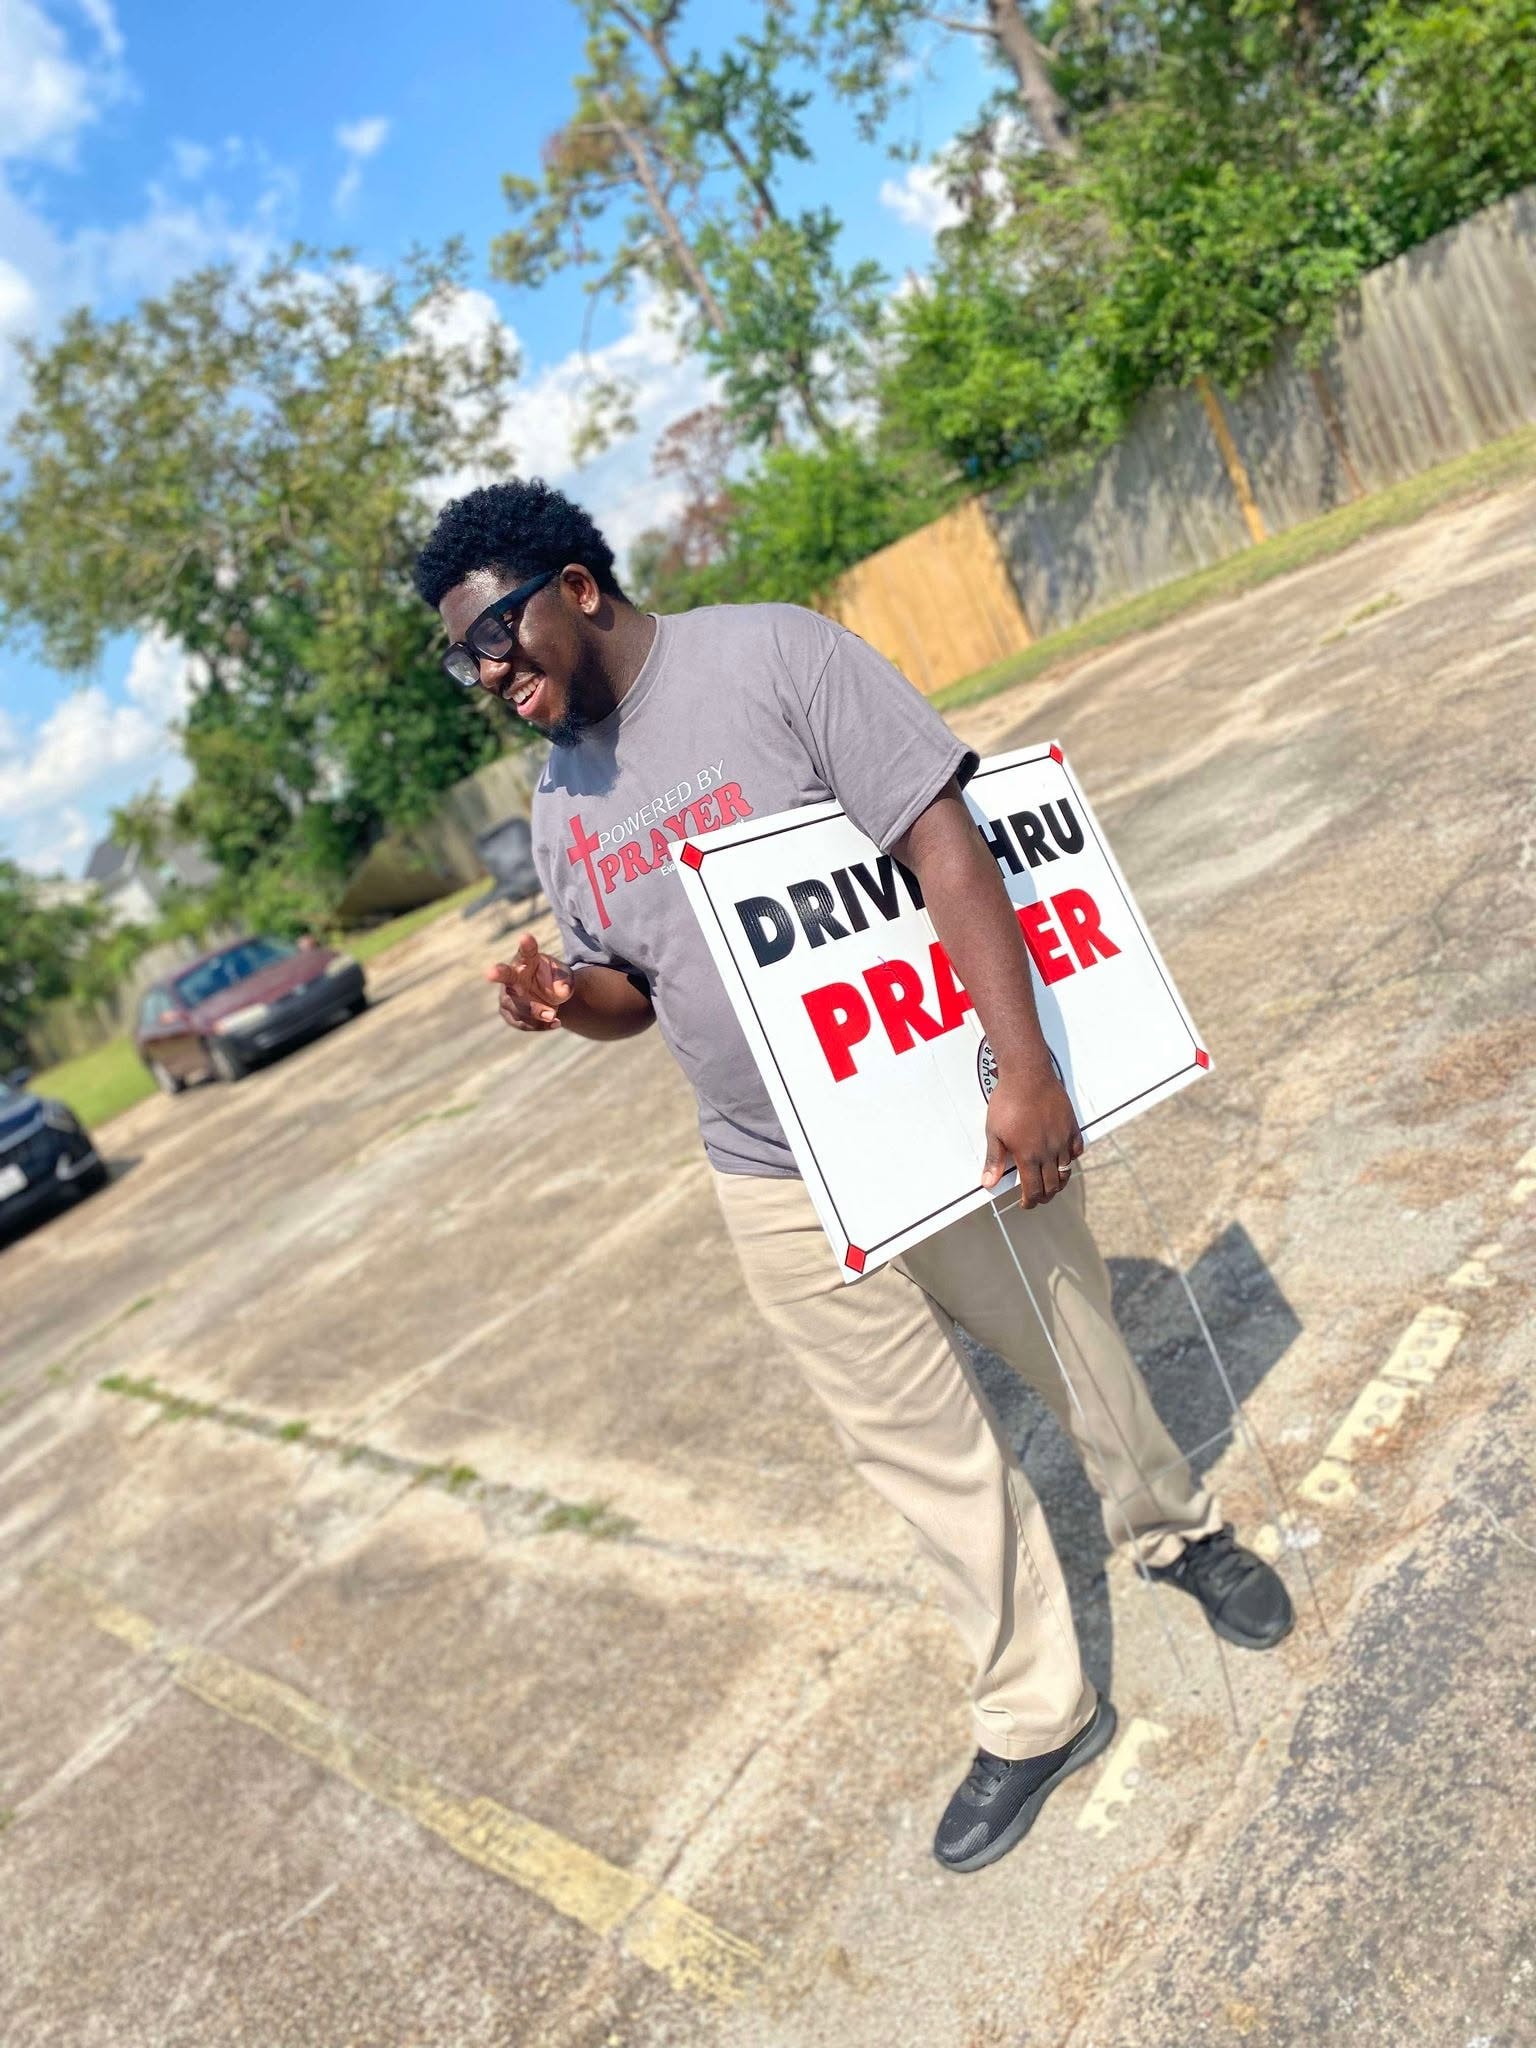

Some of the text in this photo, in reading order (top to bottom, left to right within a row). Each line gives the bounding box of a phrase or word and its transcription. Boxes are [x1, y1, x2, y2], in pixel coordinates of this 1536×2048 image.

[597, 781, 754, 894] PRAYER
[598, 760, 725, 852] POWERED BY
[978, 797, 1085, 879] HRU
[800, 888, 1122, 1083] PRAER
